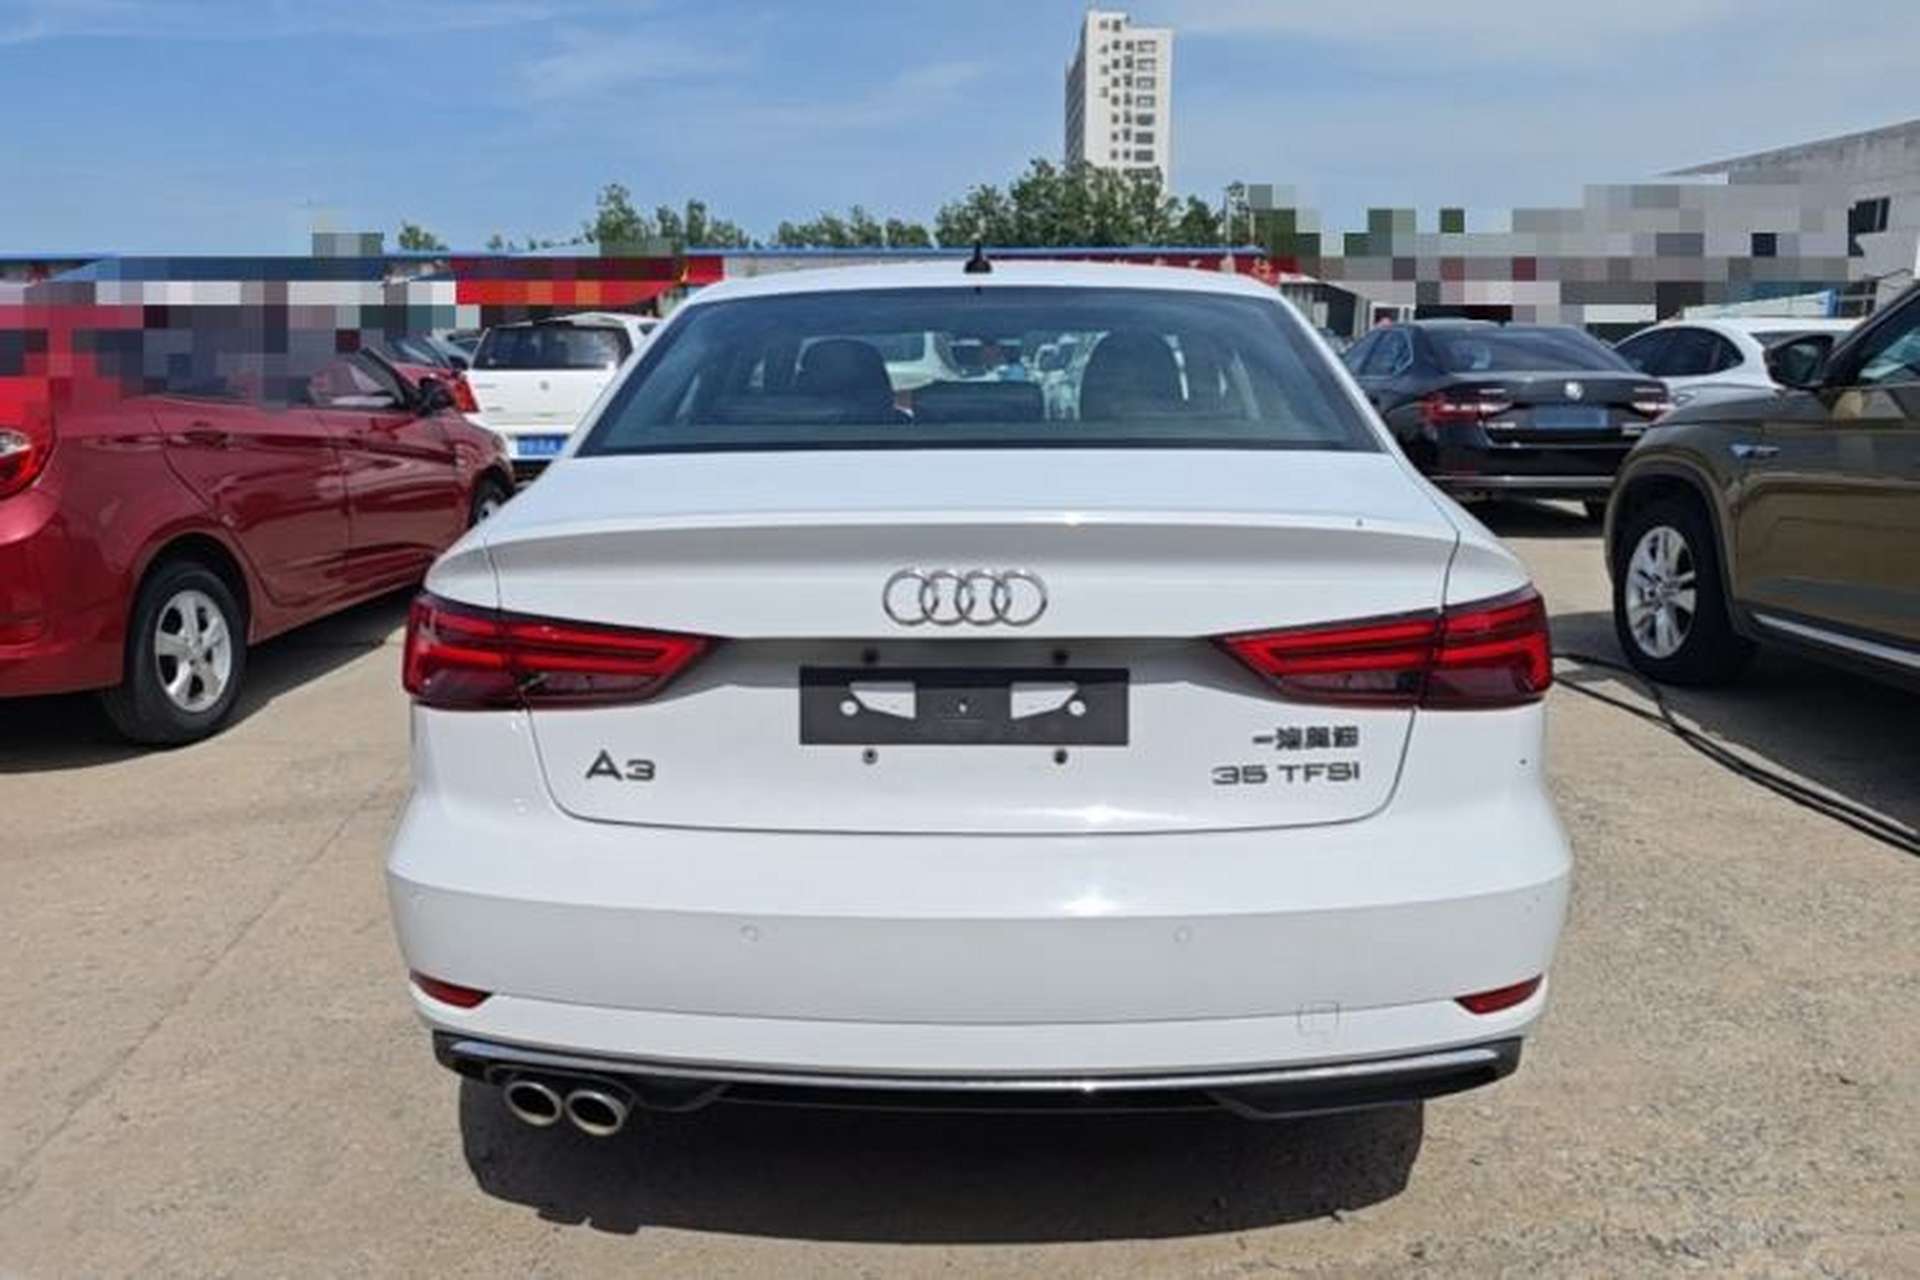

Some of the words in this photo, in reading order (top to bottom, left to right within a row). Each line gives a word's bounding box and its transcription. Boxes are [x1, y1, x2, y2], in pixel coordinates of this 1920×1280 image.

[585, 749, 656, 781] A3
[1211, 764, 1268, 785] 35
[1276, 761, 1360, 783] TFSI
